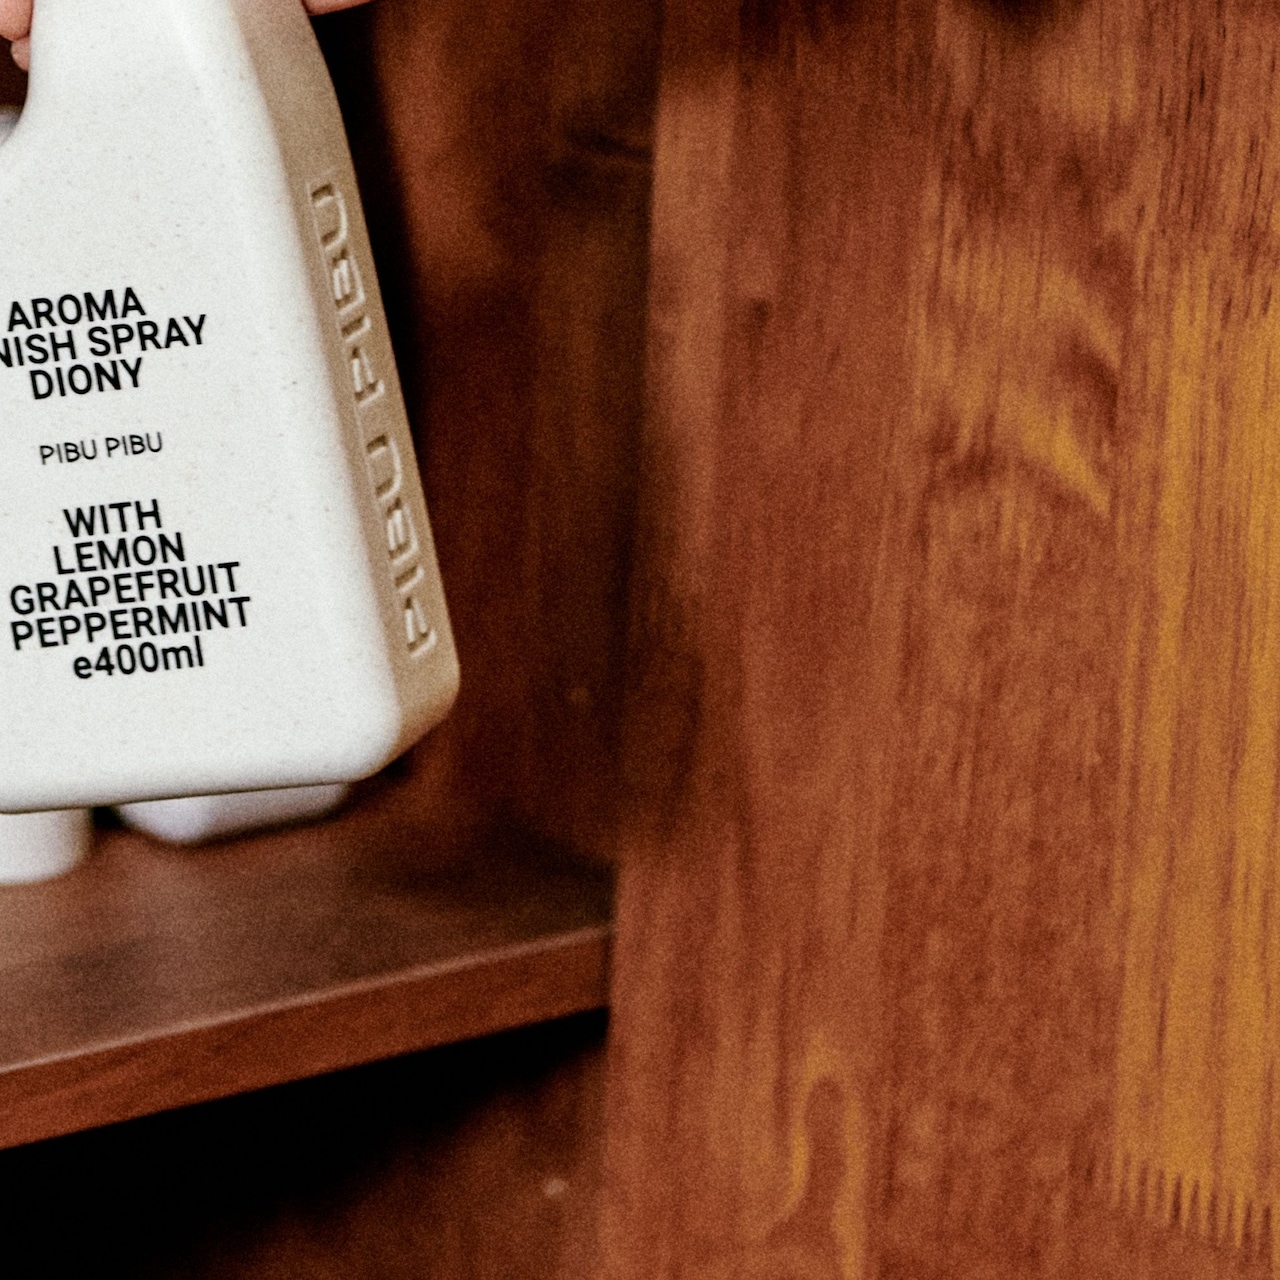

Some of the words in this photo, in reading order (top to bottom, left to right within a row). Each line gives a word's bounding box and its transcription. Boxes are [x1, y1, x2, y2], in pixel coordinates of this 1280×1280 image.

[8, 287, 146, 332] AROMA
[88, 314, 206, 357] SPRAY
[30, 357, 142, 399] DIONY
[39, 439, 98, 465] PIBU
[105, 432, 163, 458] PIBU
[63, 499, 162, 537] WITH
[53, 532, 186, 575] LEMON
[10, 562, 240, 615] GRAPEFRUIT
[10, 597, 250, 650] PEPPERMINT
[73, 635, 204, 679] e400ml
